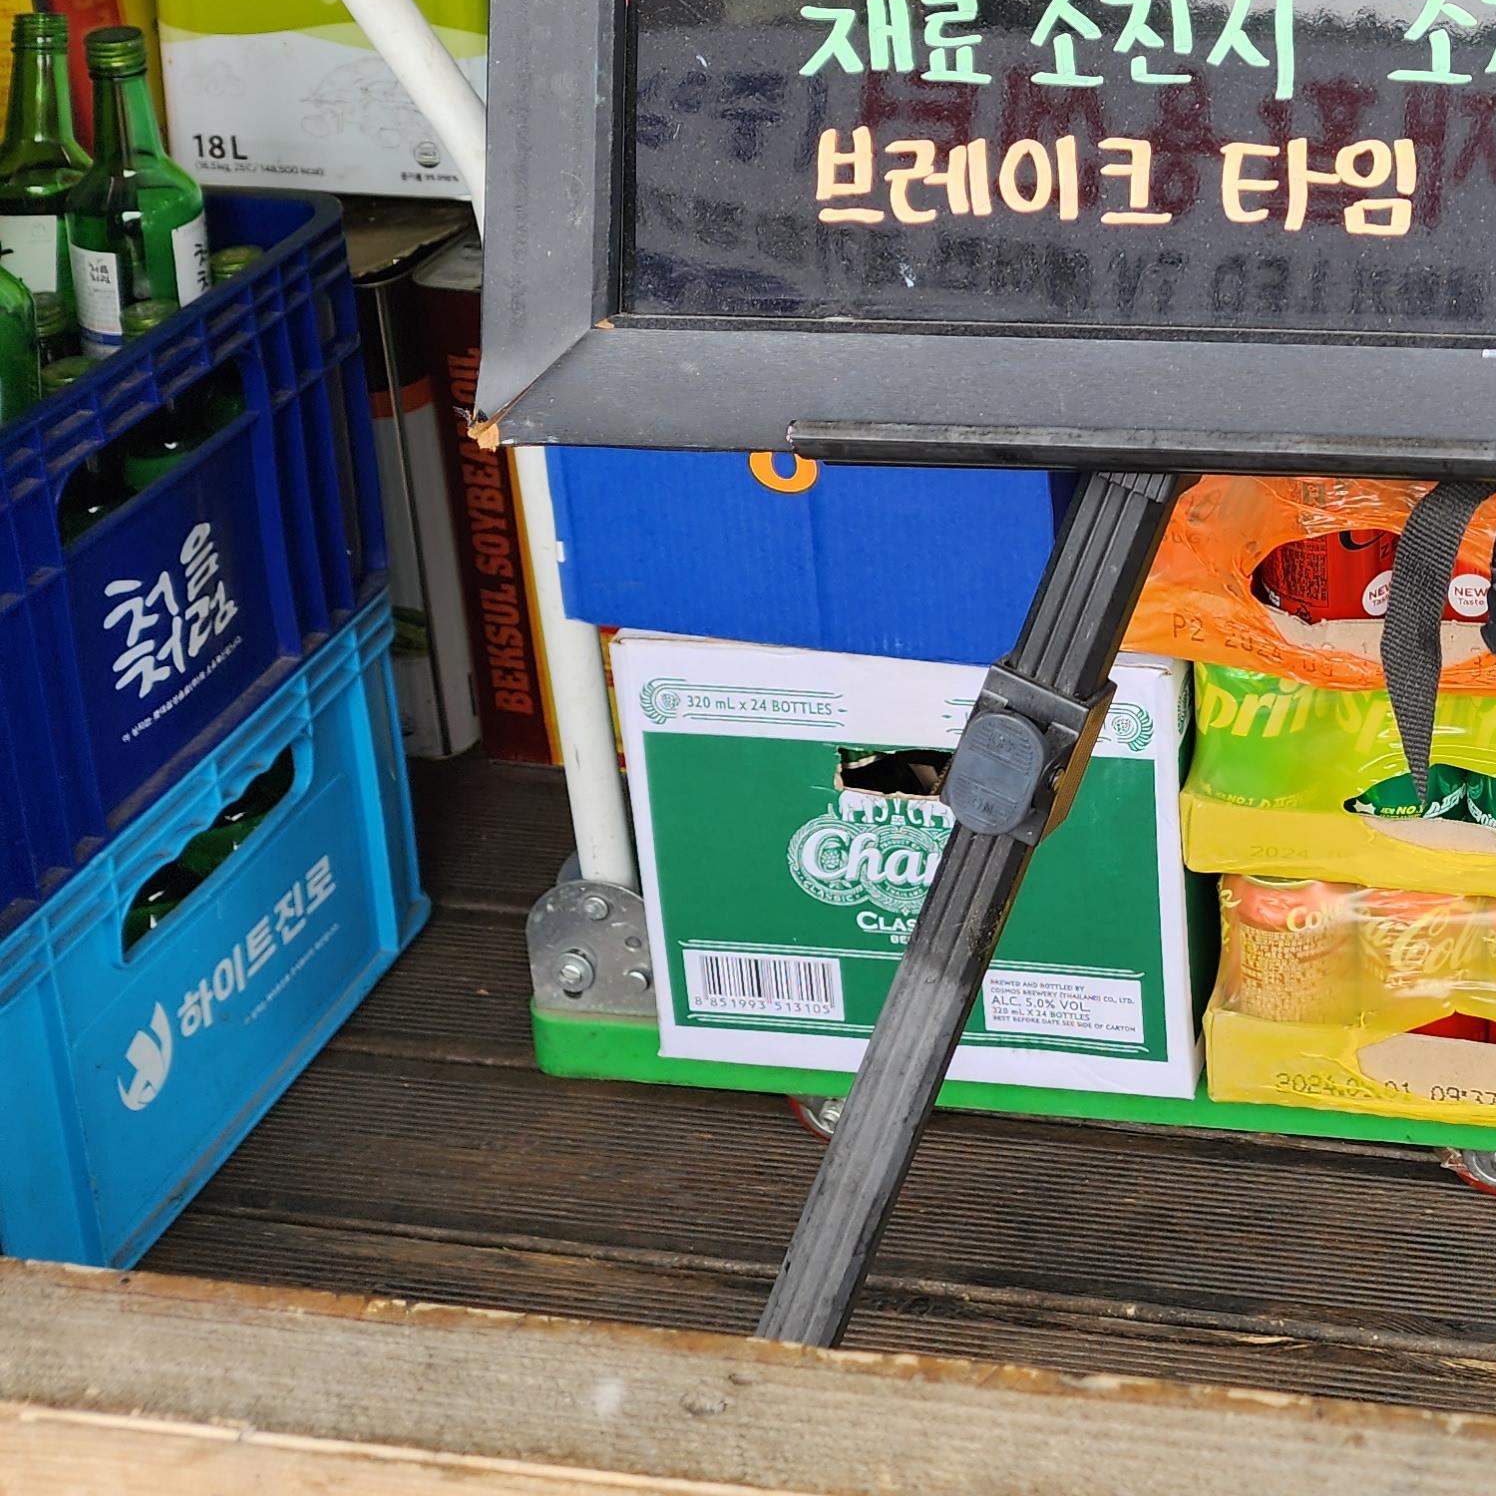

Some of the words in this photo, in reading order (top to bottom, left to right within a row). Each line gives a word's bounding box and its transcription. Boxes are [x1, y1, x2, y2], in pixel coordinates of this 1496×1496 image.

[815, 124, 1173, 226] 브레이크
[1221, 137, 1418, 237] 타임
[1454, 585, 1489, 598] NEW
[479, 588, 535, 716] BEKSUL
[687, 695, 710, 709] 320
[715, 696, 736, 711] mL
[750, 698, 767, 712] 24
[771, 700, 833, 716] BOTTLES
[178, 855, 338, 1038] 하이트진로
[1025, 997, 1056, 1009] 5.0%
[1049, 1011, 1091, 1021] BOTTLES
